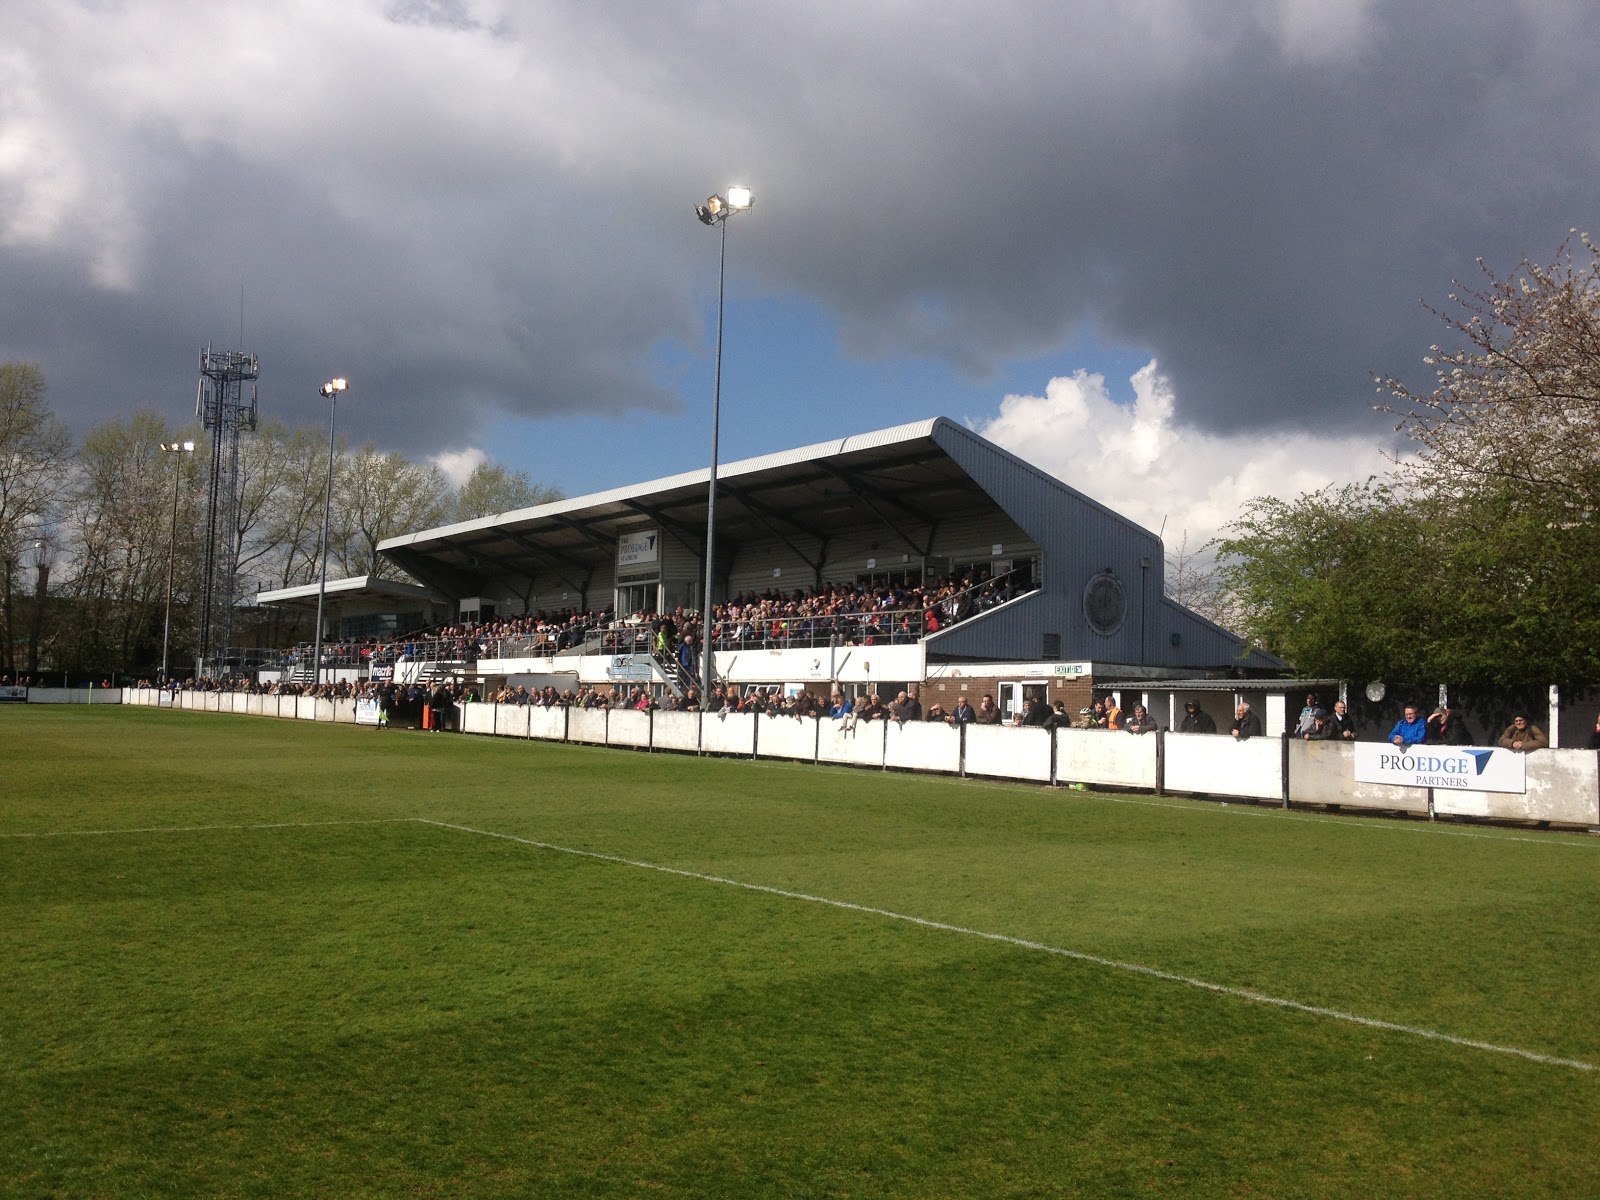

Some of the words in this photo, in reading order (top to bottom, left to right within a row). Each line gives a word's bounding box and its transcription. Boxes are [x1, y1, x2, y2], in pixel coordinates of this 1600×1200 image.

[620, 542, 648, 555] PROEDGE
[1055, 665, 1070, 674] EXIT
[1379, 754, 1469, 774] PROEDGE
[1416, 775, 1468, 787] PARTNERS
